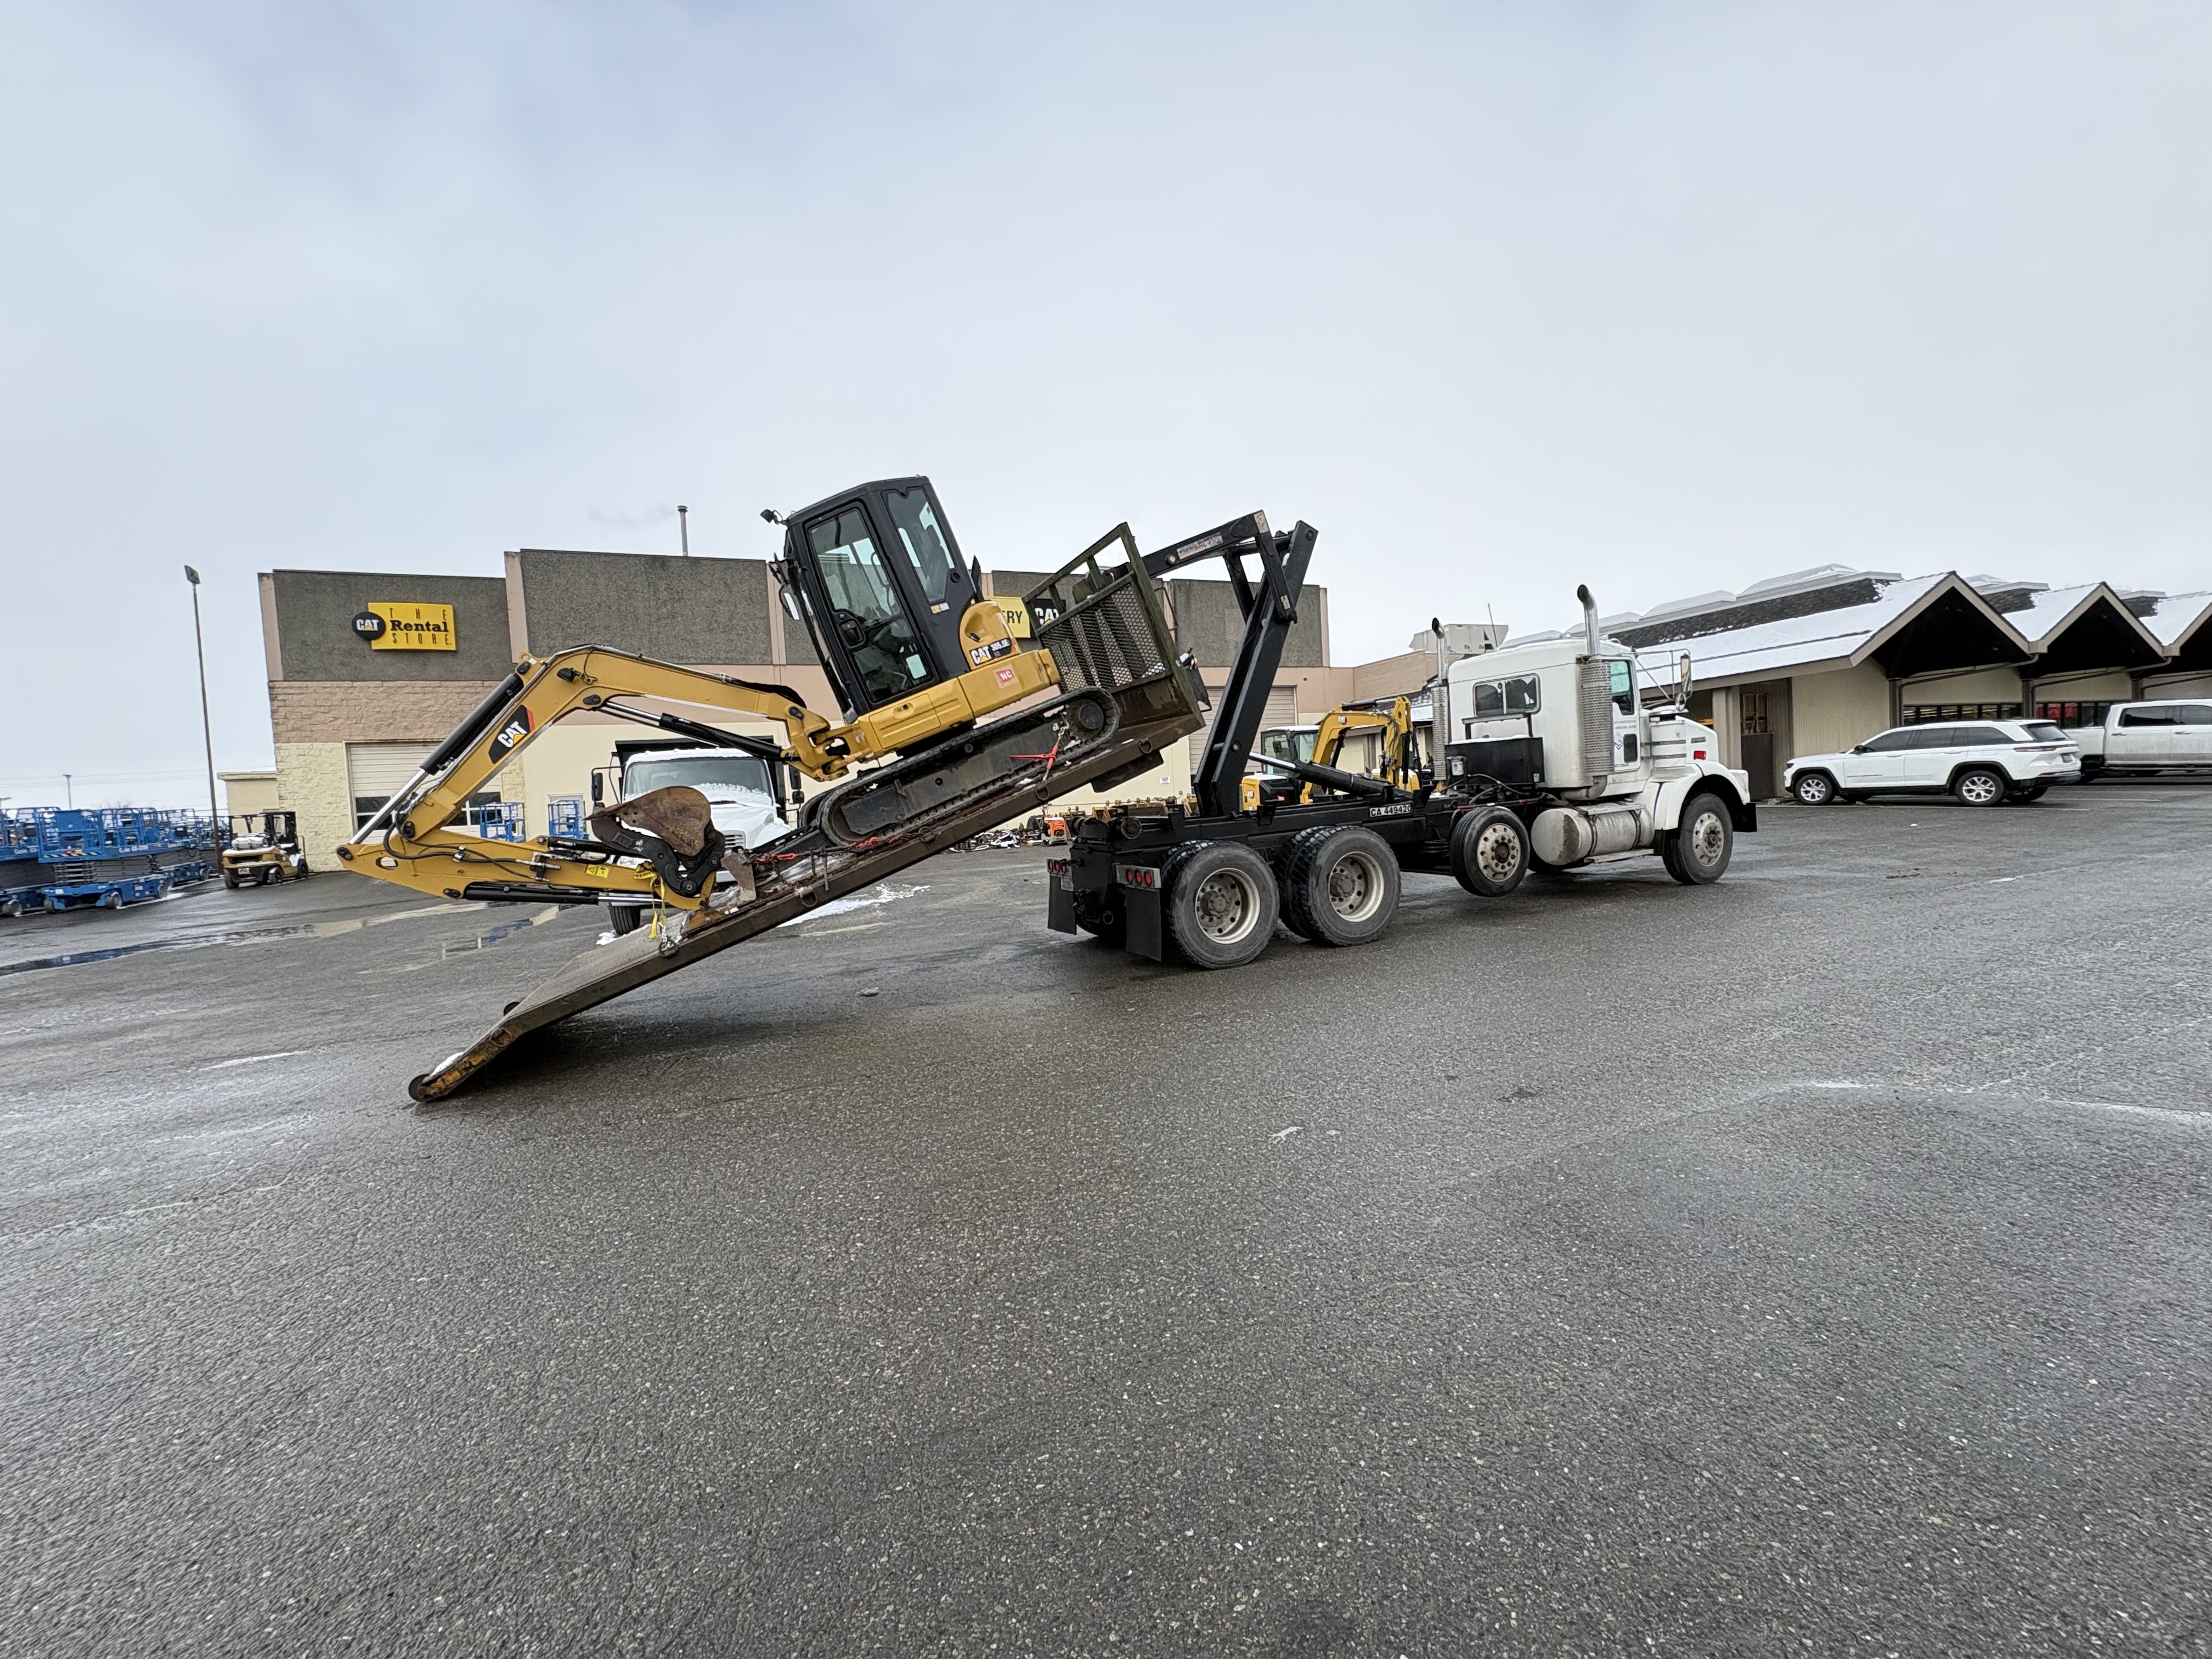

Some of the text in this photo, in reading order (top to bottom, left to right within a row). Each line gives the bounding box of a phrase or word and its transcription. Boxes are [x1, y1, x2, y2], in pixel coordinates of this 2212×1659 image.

[389, 608, 447, 620] THE
[357, 619, 380, 631] CAT
[390, 620, 449, 633] Rental
[392, 633, 449, 645] STORE
[971, 646, 992, 664] CAT
[1000, 670, 1012, 680] NC
[498, 721, 527, 748] CAT
[1384, 805, 1412, 815] 449420
